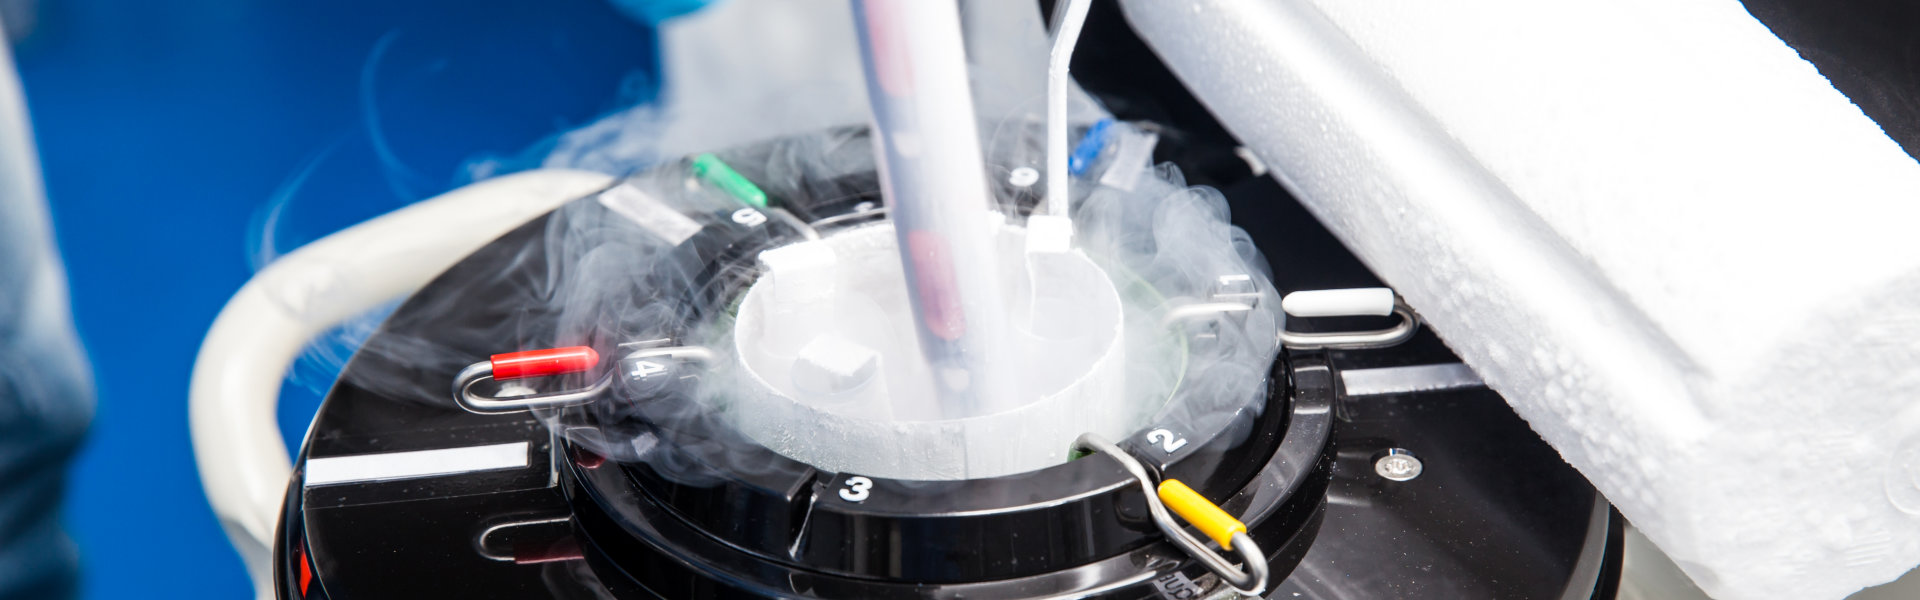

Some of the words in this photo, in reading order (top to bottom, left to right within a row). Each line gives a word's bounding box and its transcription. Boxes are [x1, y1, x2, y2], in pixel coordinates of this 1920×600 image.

[631, 360, 665, 378] 4
[1147, 429, 1186, 453] 2
[839, 476, 873, 501] 3
